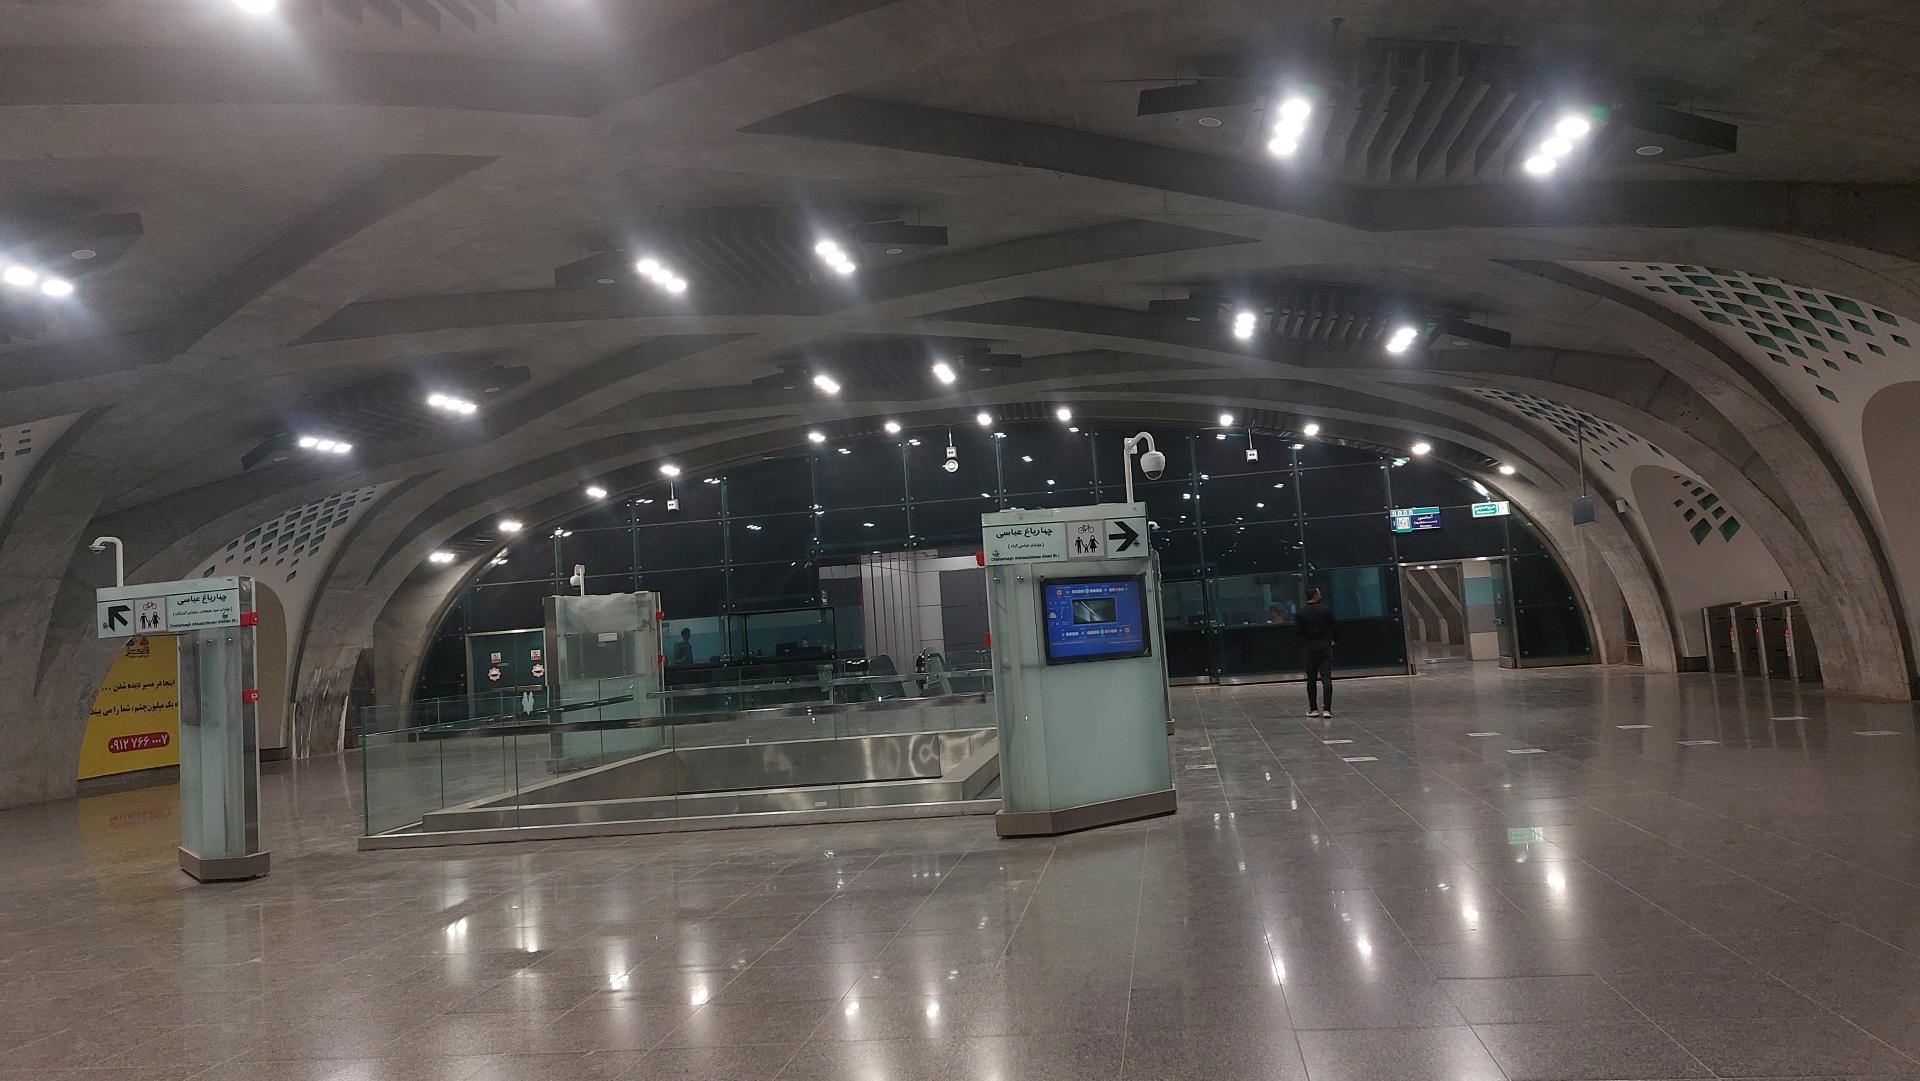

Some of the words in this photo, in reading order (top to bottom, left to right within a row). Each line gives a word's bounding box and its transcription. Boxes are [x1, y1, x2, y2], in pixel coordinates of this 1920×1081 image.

[996, 528, 1023, 539] عباسی
[1024, 526, 1053, 538] چهارباغ
[177, 595, 201, 606] عباسی
[202, 593, 227, 604] چهارباغ
[155, 680, 163, 689] در
[162, 679, 176, 688] اینجا
